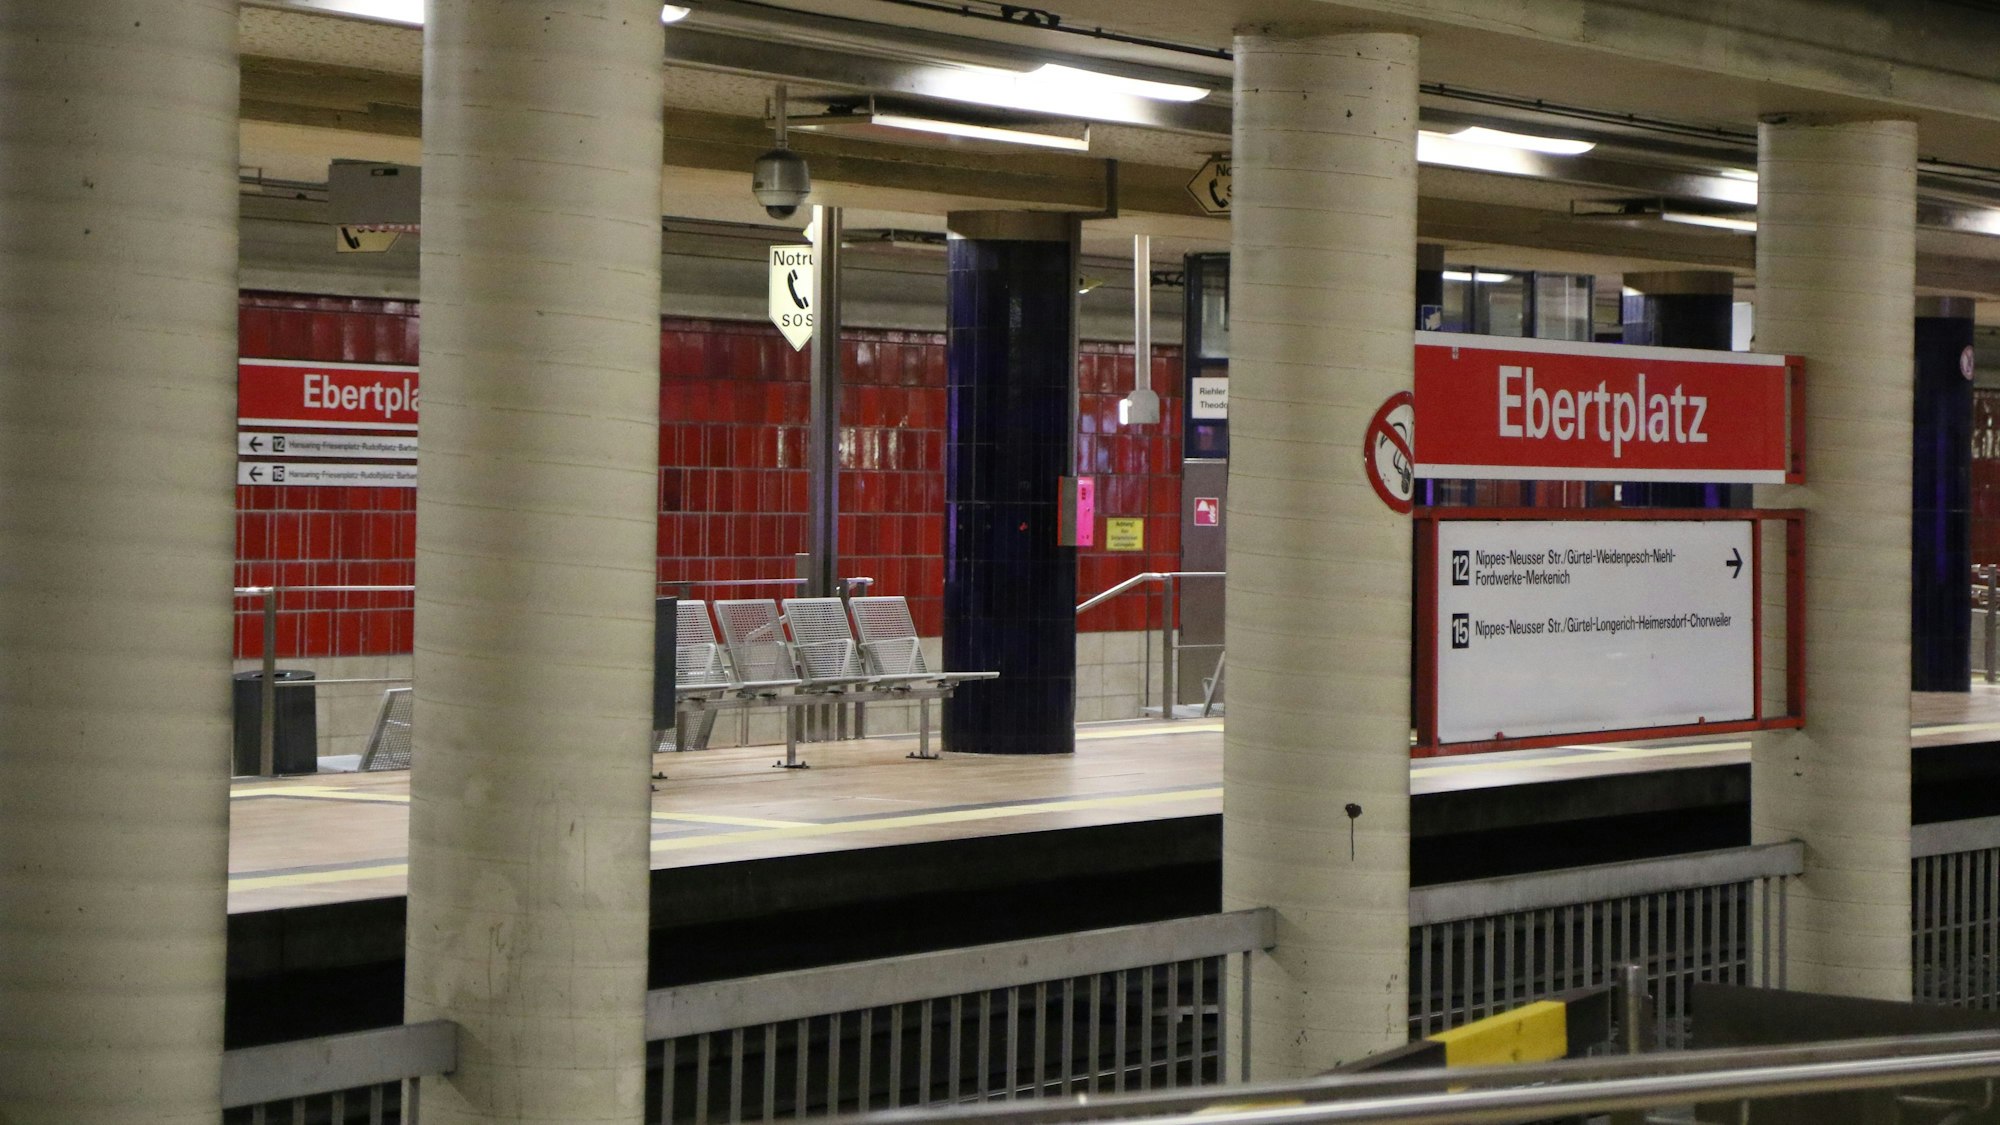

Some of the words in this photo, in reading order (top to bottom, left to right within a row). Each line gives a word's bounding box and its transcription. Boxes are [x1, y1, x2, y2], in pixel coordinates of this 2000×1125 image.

[782, 313, 813, 327] SOS
[1199, 387, 1226, 395] Riehler
[1499, 364, 1708, 459] Ebertplatz
[273, 437, 284, 451] 12
[273, 467, 284, 481] 15
[1453, 553, 1469, 583] 12
[1475, 549, 1545, 568] Nippes-Neusser
[1548, 548, 1676, 566] Str./Gürtel-Weidenpesch-Niehl-
[1475, 569, 1570, 586] Fordwerke-Merkenich
[1452, 616, 1469, 646] 15
[1475, 619, 1545, 639] Nippes-Neusser
[1548, 612, 1732, 635] Str./Gürtel-Longerich-Heimersdorf-Chorweiler
